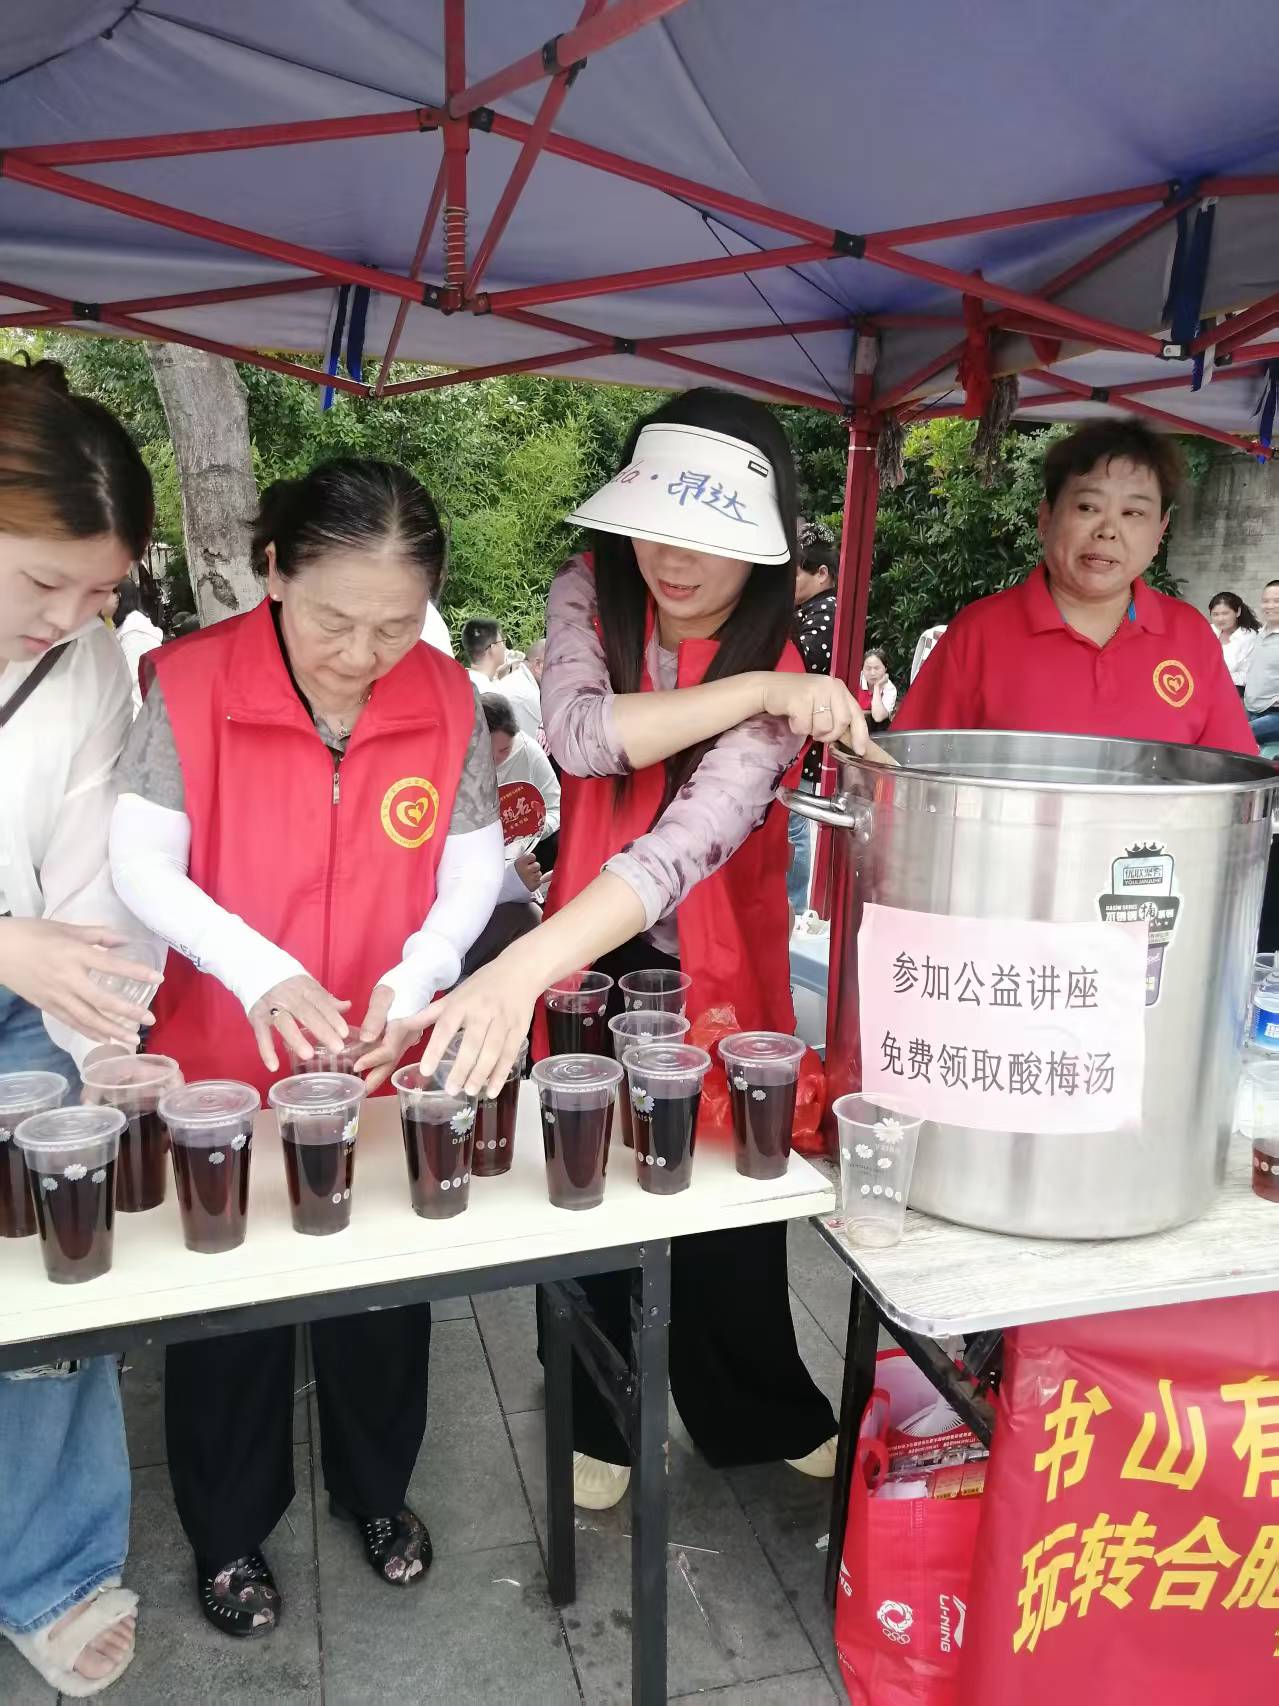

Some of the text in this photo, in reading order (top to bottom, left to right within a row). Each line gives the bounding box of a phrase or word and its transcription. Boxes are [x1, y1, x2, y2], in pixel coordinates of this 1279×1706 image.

[892, 951, 1099, 1011] 参加公益讲座
[880, 1030, 1115, 1096] 免费领取酸梅汤
[1034, 1375, 1279, 1502] 书山有
[939, 1594, 951, 1652] LI-NING
